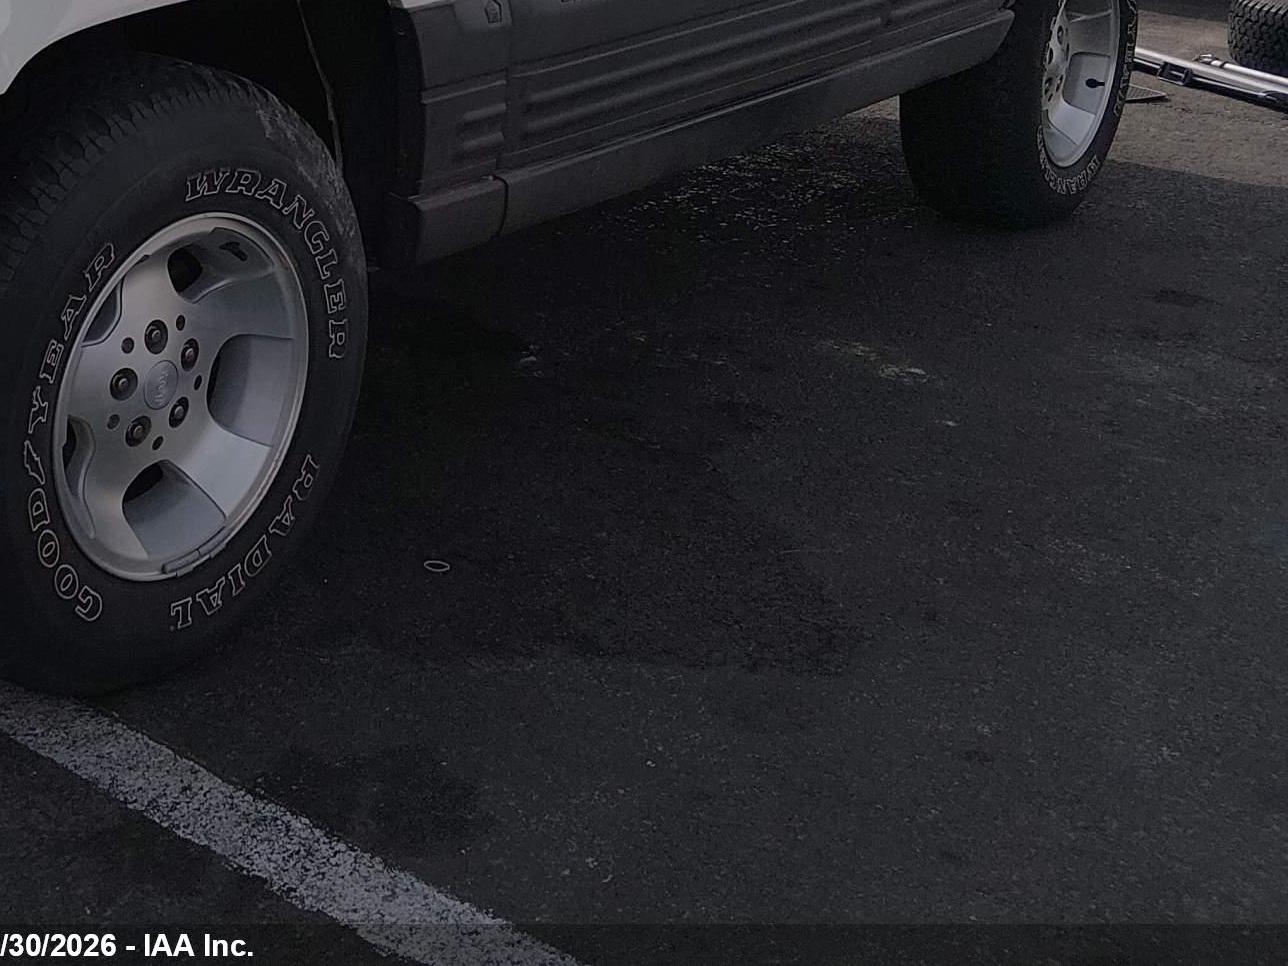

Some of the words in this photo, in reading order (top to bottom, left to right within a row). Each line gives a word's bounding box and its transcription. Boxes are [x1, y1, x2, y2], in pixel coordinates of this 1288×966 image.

[185, 168, 350, 359] WRANGLER
[23, 242, 116, 622] GOODYEAR
[170, 454, 320, 629] RADIAL
